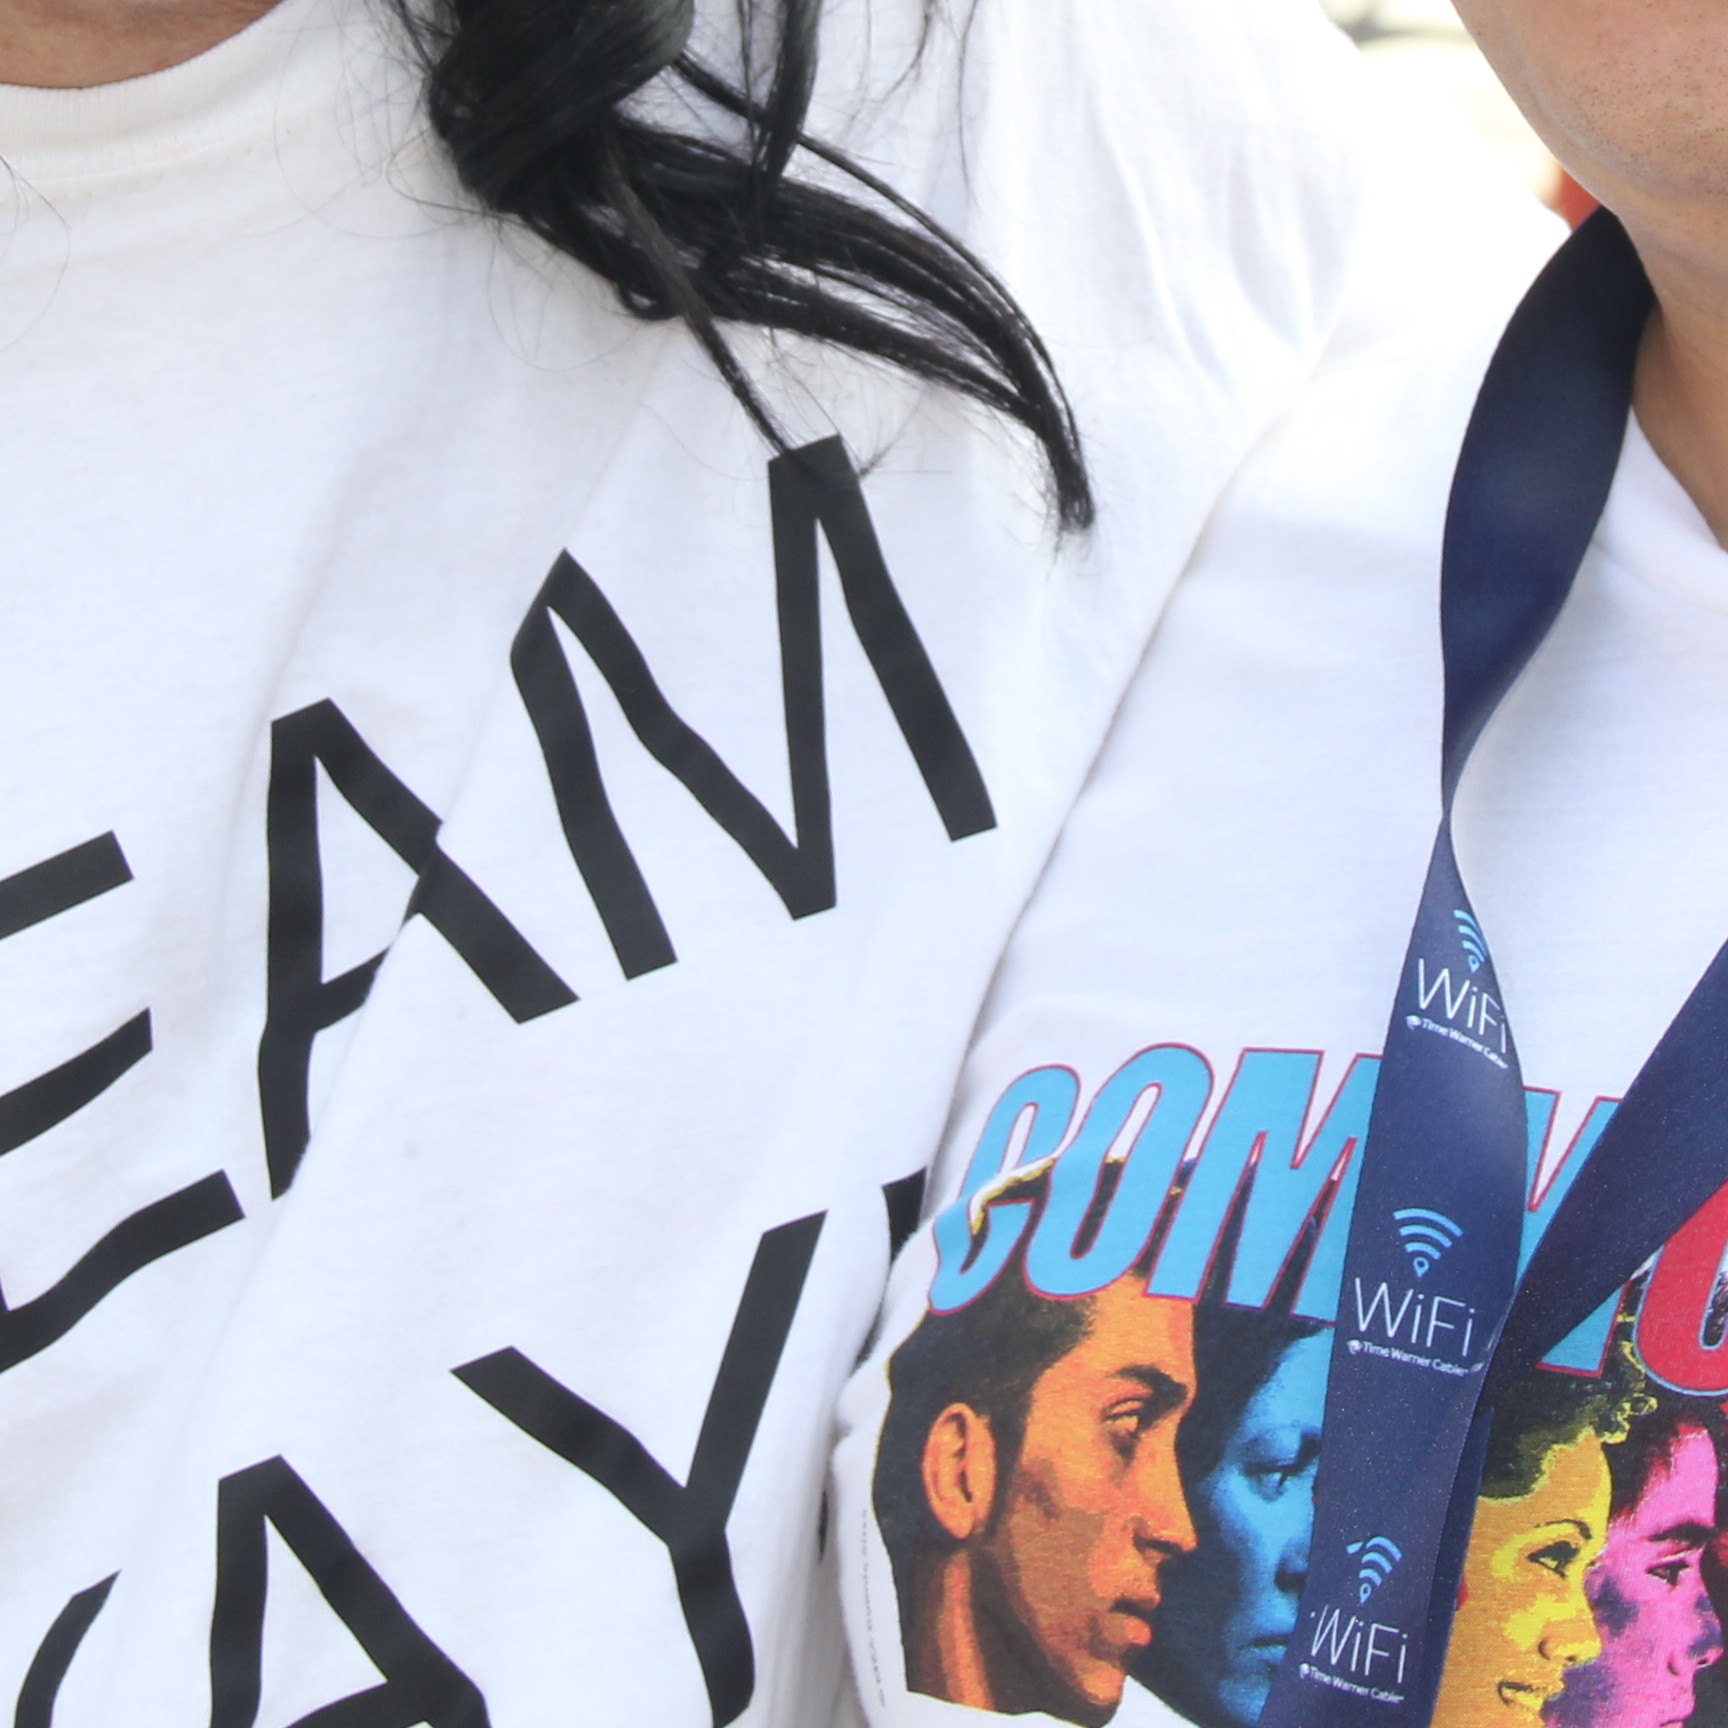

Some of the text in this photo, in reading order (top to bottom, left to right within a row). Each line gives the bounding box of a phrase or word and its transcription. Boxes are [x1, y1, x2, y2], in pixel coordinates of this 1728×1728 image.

[1419, 958, 1507, 1054] WiFi
[1355, 1277, 1476, 1357] WiFi
[1390, 1347, 1432, 1369] Warner
[1310, 1604, 1408, 1684] WiFi
